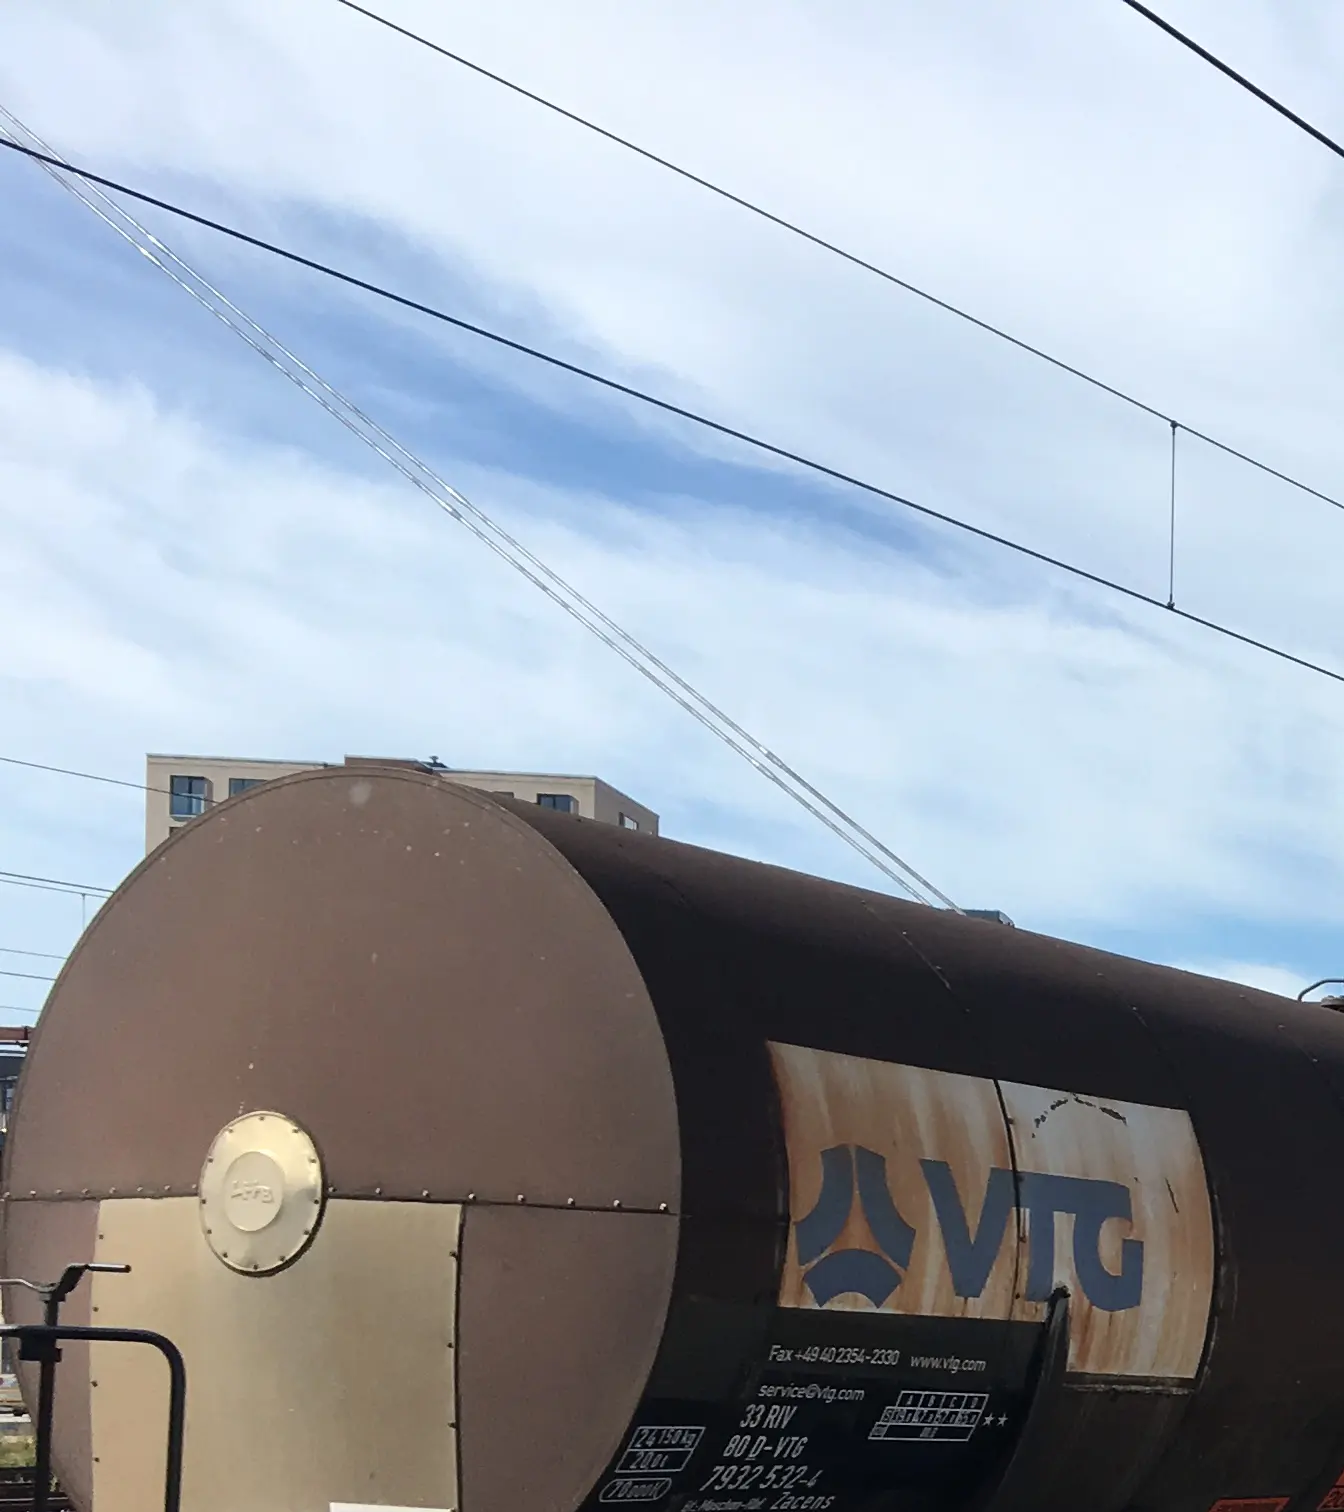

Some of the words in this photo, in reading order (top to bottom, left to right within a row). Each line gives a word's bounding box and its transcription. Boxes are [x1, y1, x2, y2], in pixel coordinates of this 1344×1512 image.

[920, 1158, 1144, 1313] VTG
[768, 1344, 793, 1362] Fax
[795, 1346, 819, 1363] +49
[818, 1346, 835, 1364] 40
[836, 1346, 900, 1366] 2354-2330
[910, 1354, 987, 1374] www.vtg.com
[758, 1382, 865, 1403] service@vtg.com
[739, 1404, 765, 1429] 33
[762, 1404, 798, 1430] RIV
[723, 1434, 748, 1458] 80
[745, 1435, 809, 1461] D-VTG
[699, 1465, 762, 1491] 7932
[759, 1465, 824, 1490] 532-4
[769, 1490, 837, 1511] Zacens
